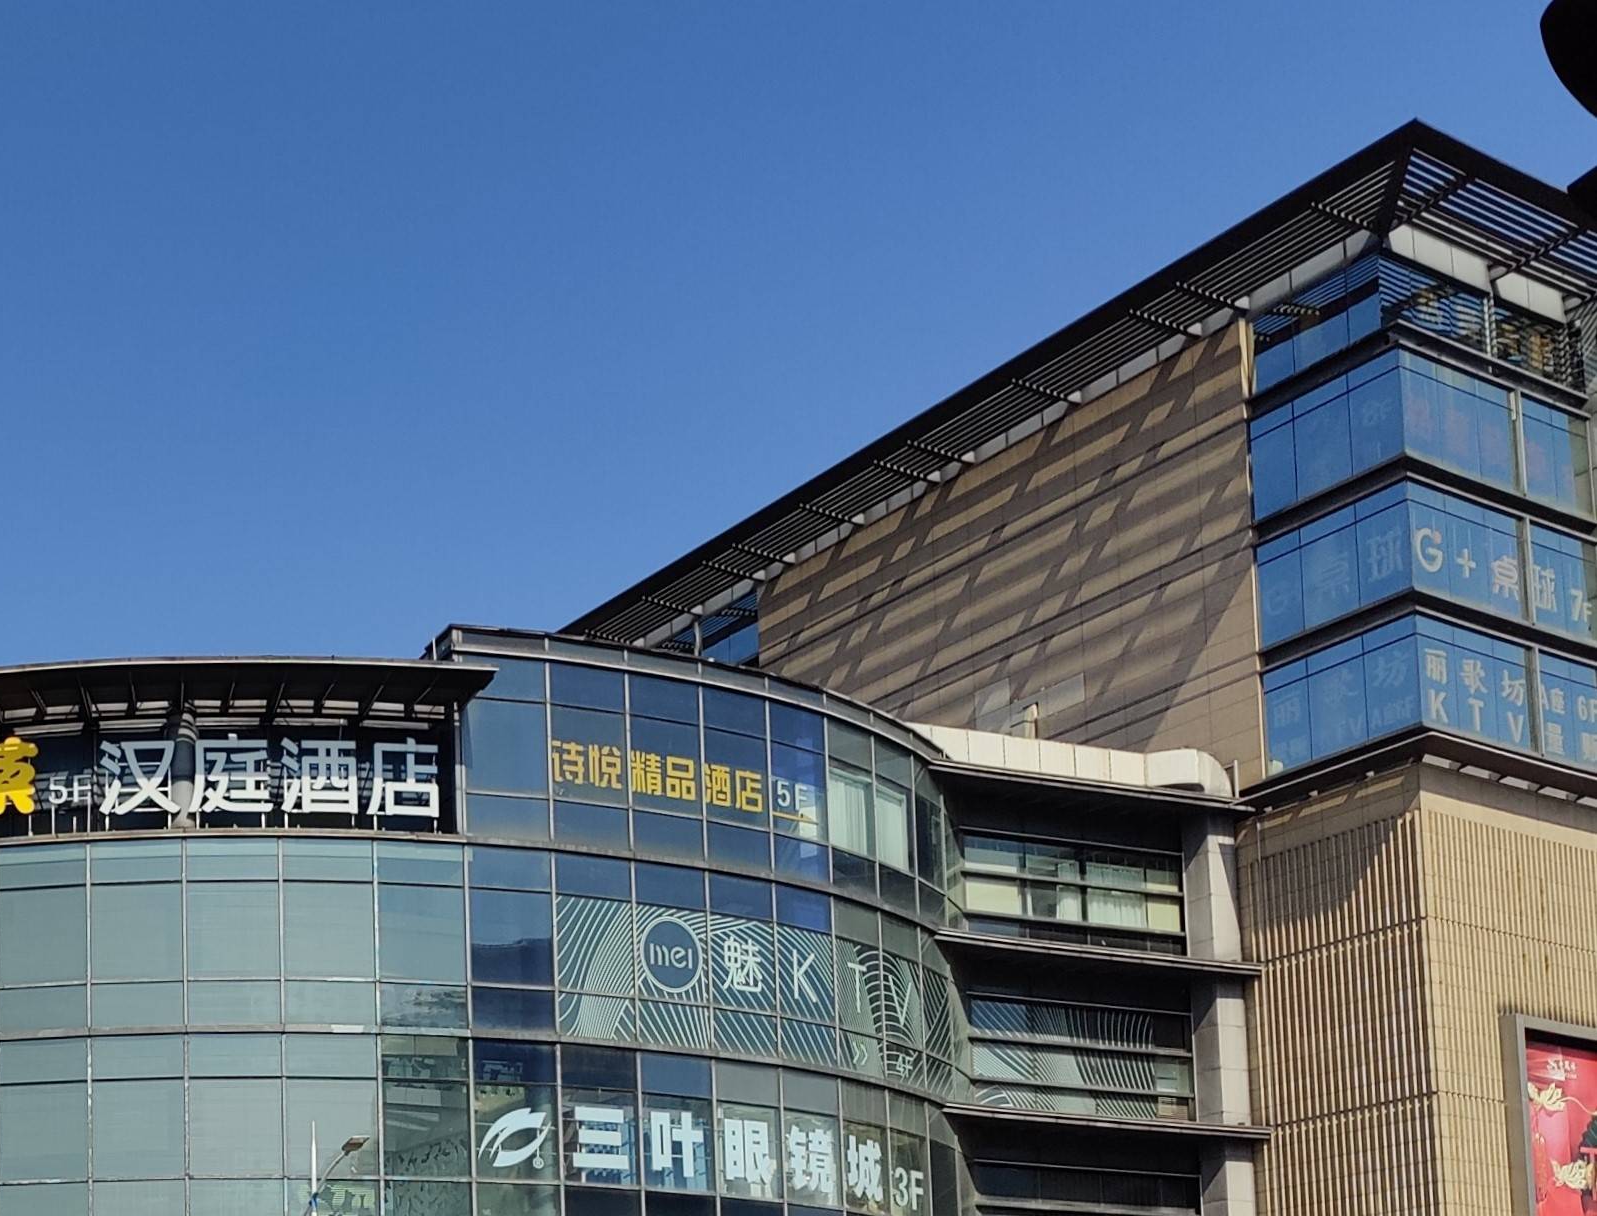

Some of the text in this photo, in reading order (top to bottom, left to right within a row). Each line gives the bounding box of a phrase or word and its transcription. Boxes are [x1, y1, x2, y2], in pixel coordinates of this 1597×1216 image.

[1427, 688, 1524, 743] KTV
[49, 774, 92, 804] 5F
[99, 733, 440, 817] 汉庭酒店
[552, 740, 810, 813] 诗悦精品酒店 5F
[571, 1104, 925, 1211] 三叶眼镜城 3F
